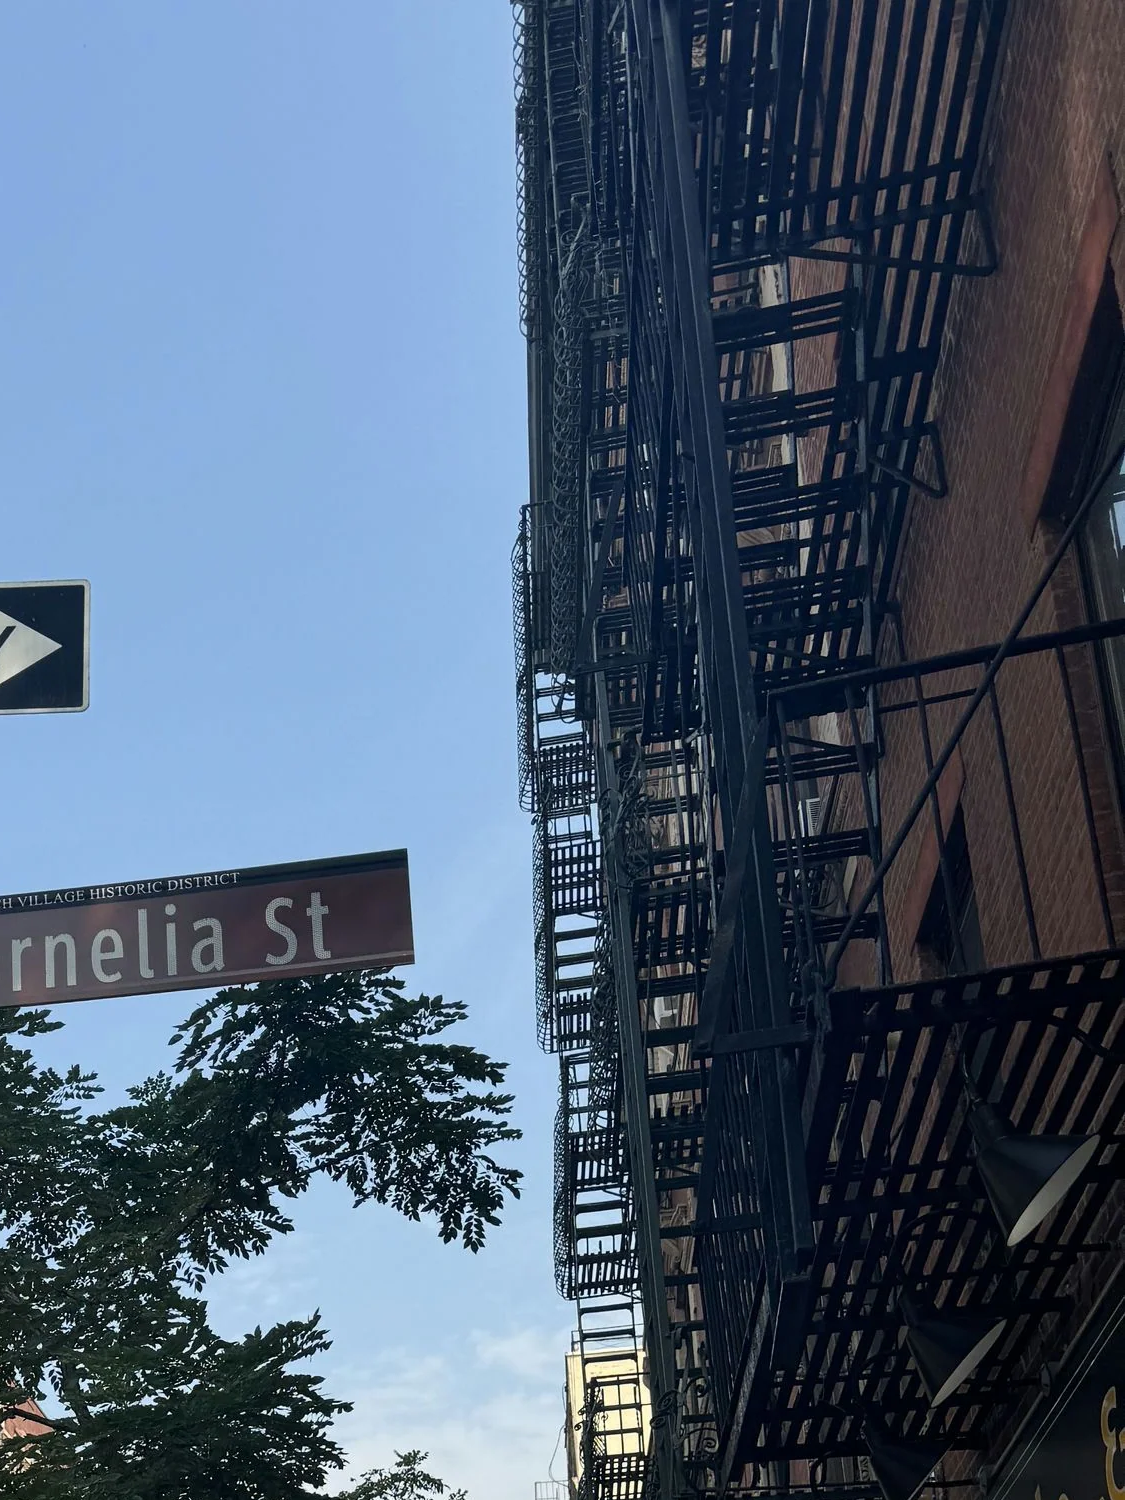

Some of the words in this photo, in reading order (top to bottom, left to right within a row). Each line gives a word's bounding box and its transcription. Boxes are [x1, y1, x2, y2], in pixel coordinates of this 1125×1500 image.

[17, 889, 86, 908] VILLAGE
[89, 880, 163, 901] HISTORIC
[167, 871, 241, 893] DISTRICT
[265, 891, 331, 966] St
